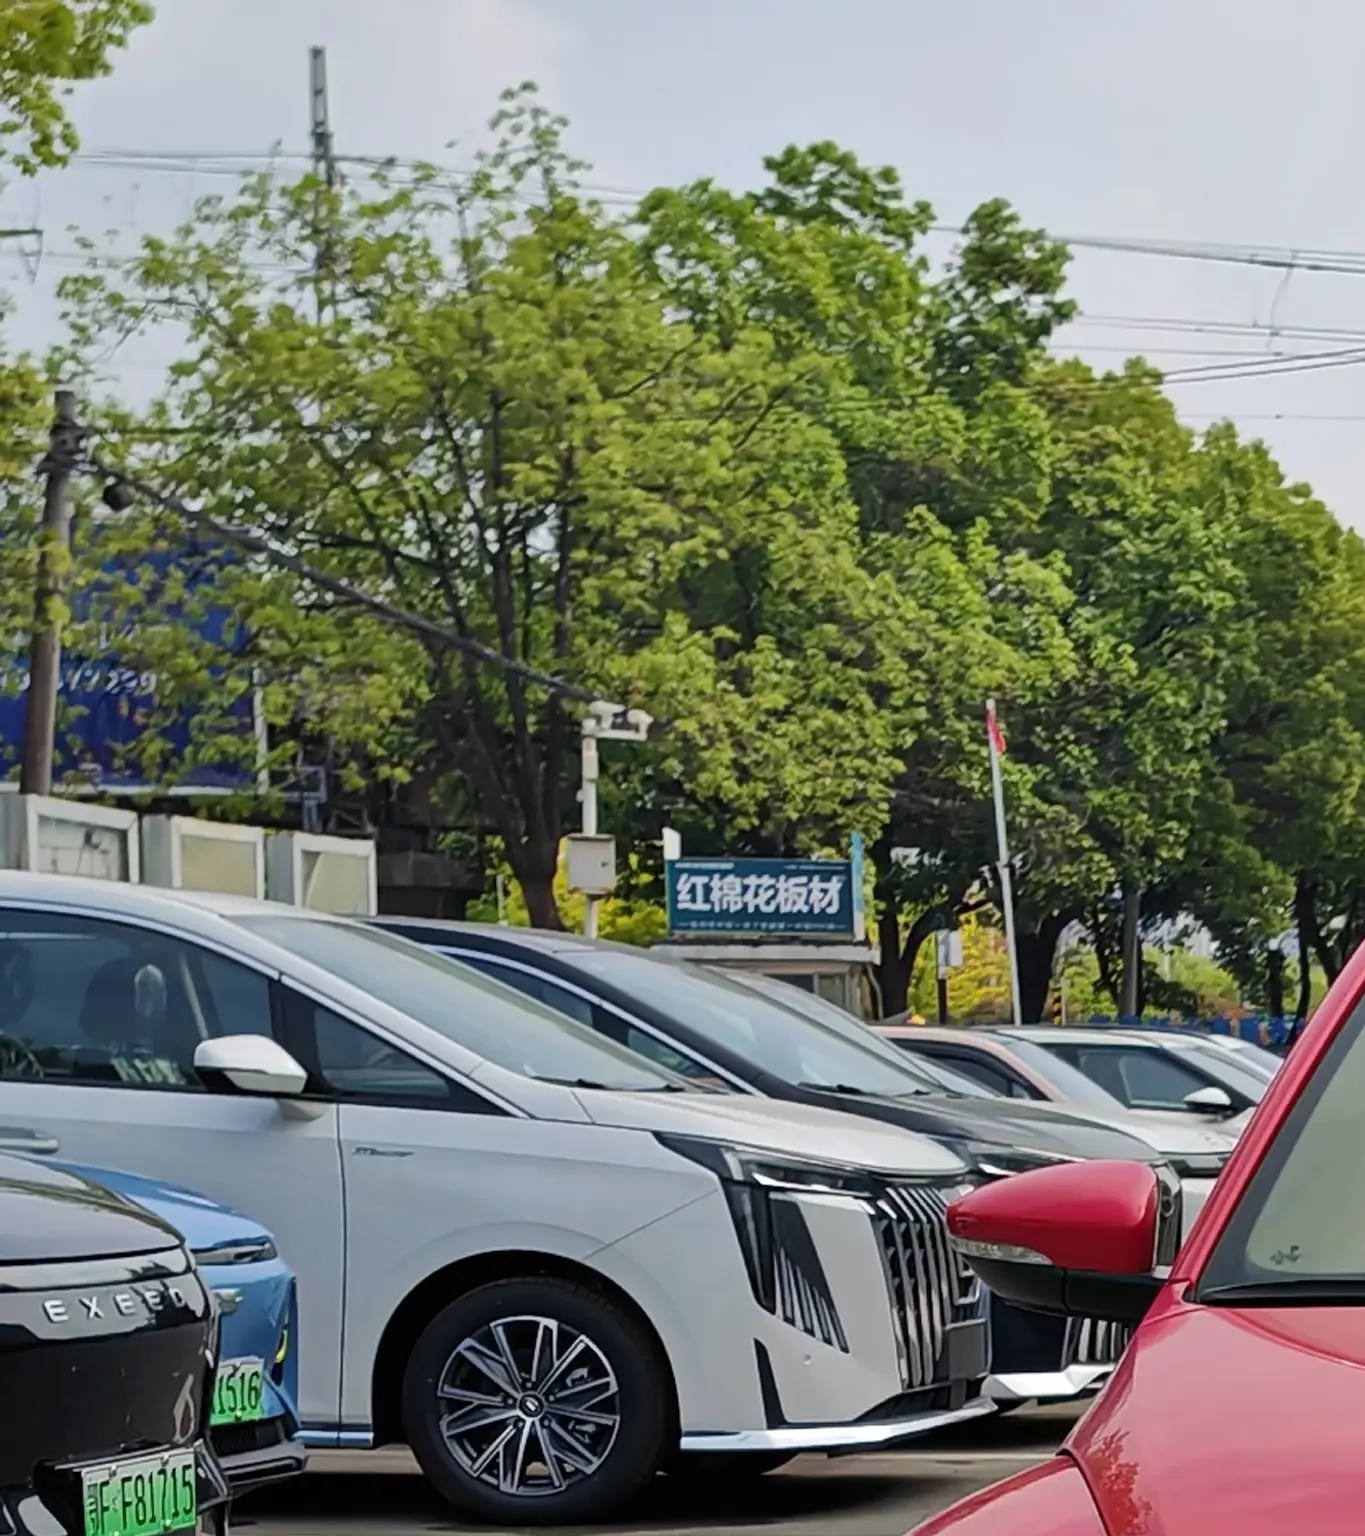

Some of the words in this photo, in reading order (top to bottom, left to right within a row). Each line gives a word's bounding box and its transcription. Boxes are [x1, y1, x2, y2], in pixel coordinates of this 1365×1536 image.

[676, 872, 843, 915] 红棉花板材
[42, 1286, 187, 1325] EXEED
[212, 1369, 260, 1416] 1516
